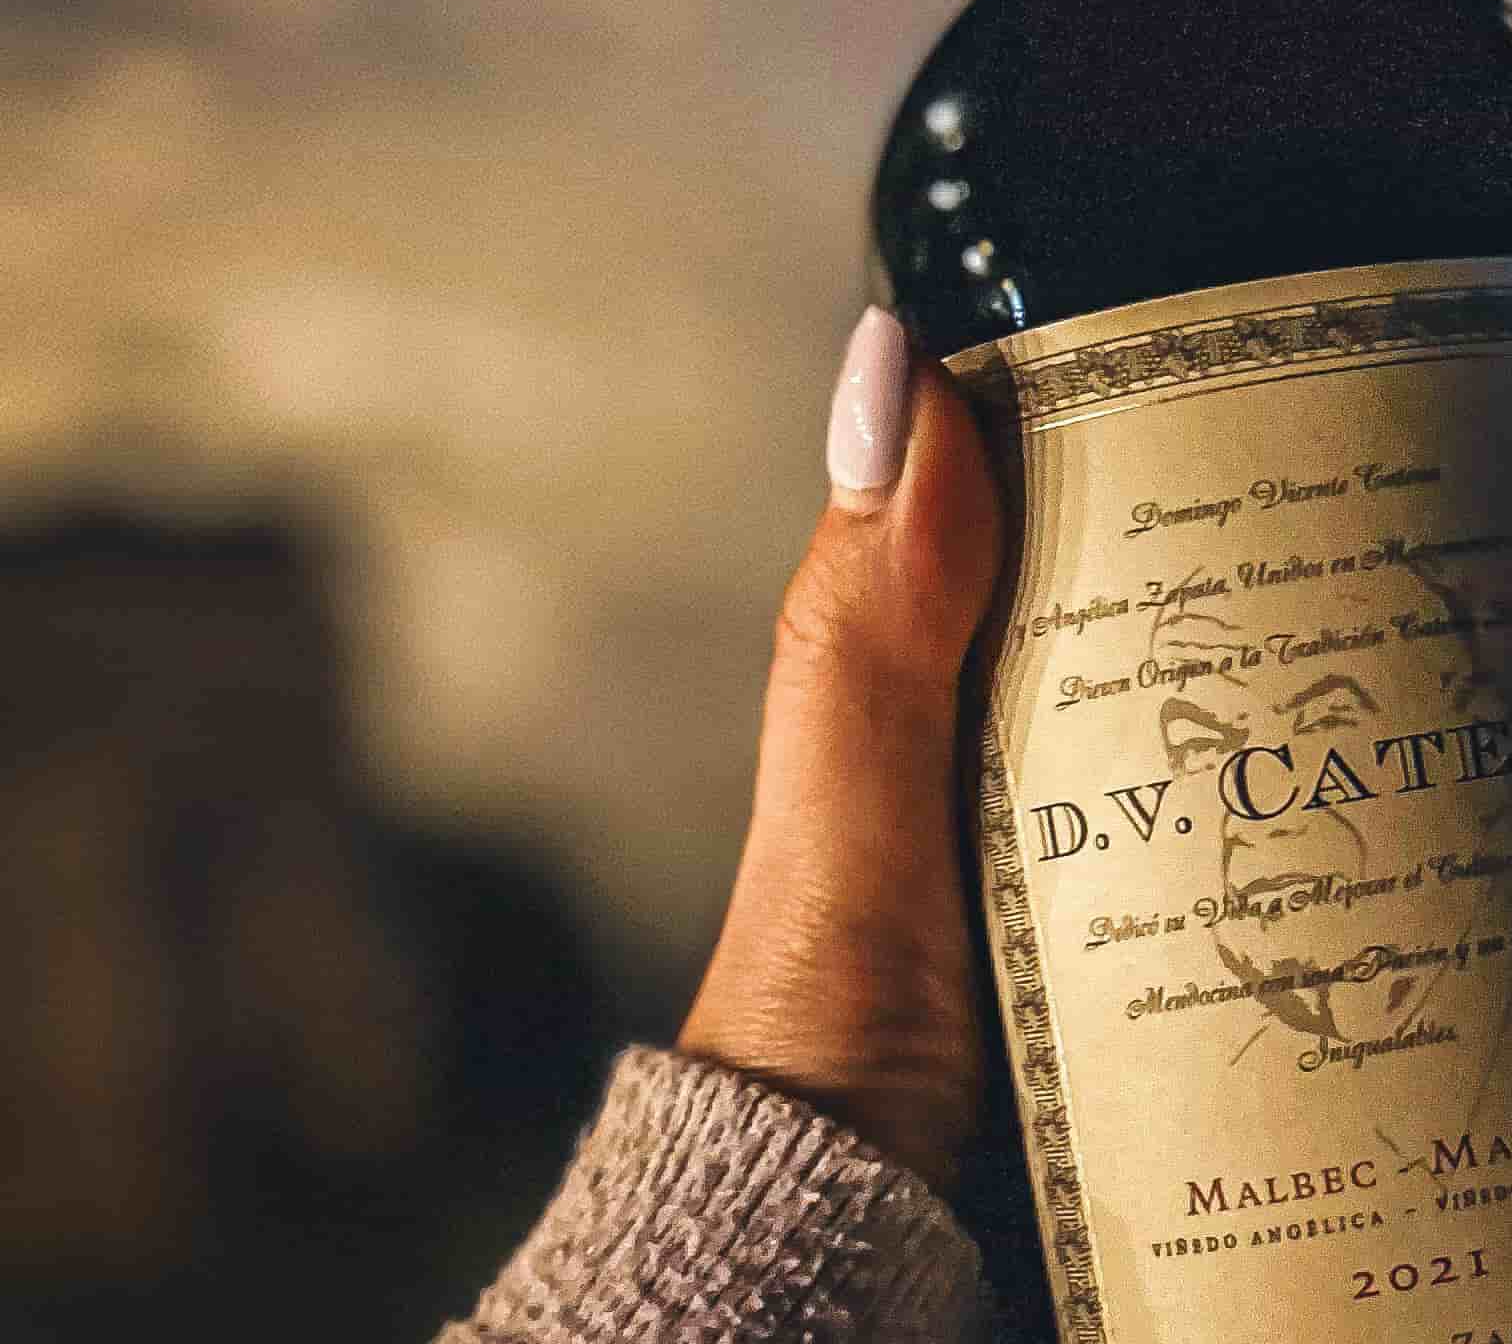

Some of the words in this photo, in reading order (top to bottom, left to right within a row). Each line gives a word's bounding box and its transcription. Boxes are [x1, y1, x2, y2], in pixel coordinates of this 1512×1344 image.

[1122, 497, 1242, 538] Domingo
[1030, 780, 1193, 862] D.V.
[1186, 1160, 1377, 1216] MALBEC
[1353, 1249, 1489, 1300] 2021
